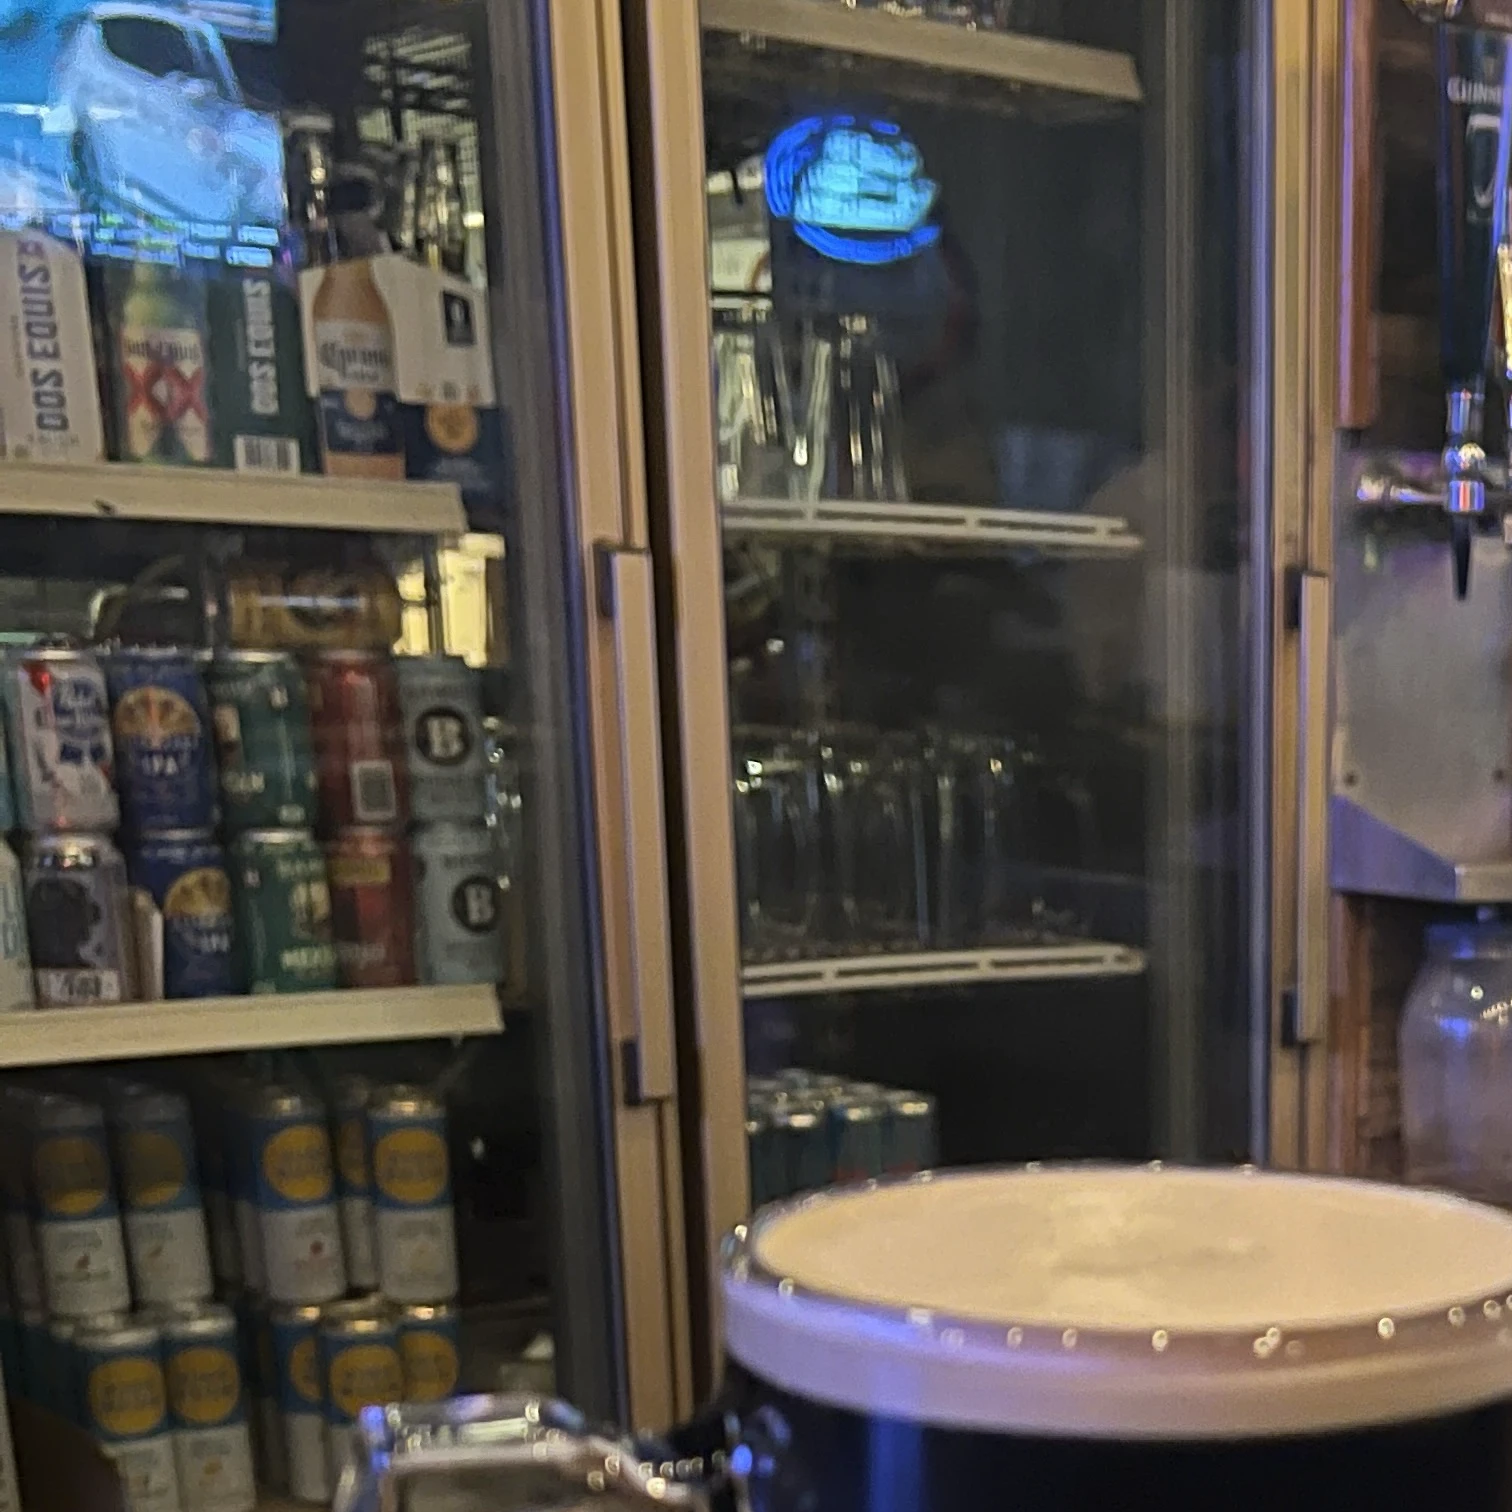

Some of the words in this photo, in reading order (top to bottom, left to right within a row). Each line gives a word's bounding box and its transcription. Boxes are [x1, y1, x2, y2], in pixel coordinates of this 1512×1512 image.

[18, 262, 62, 361] EQUIS
[30, 368, 70, 432] DOS
[248, 362, 280, 416] DOS
[427, 715, 466, 759] B
[465, 883, 495, 925] B
